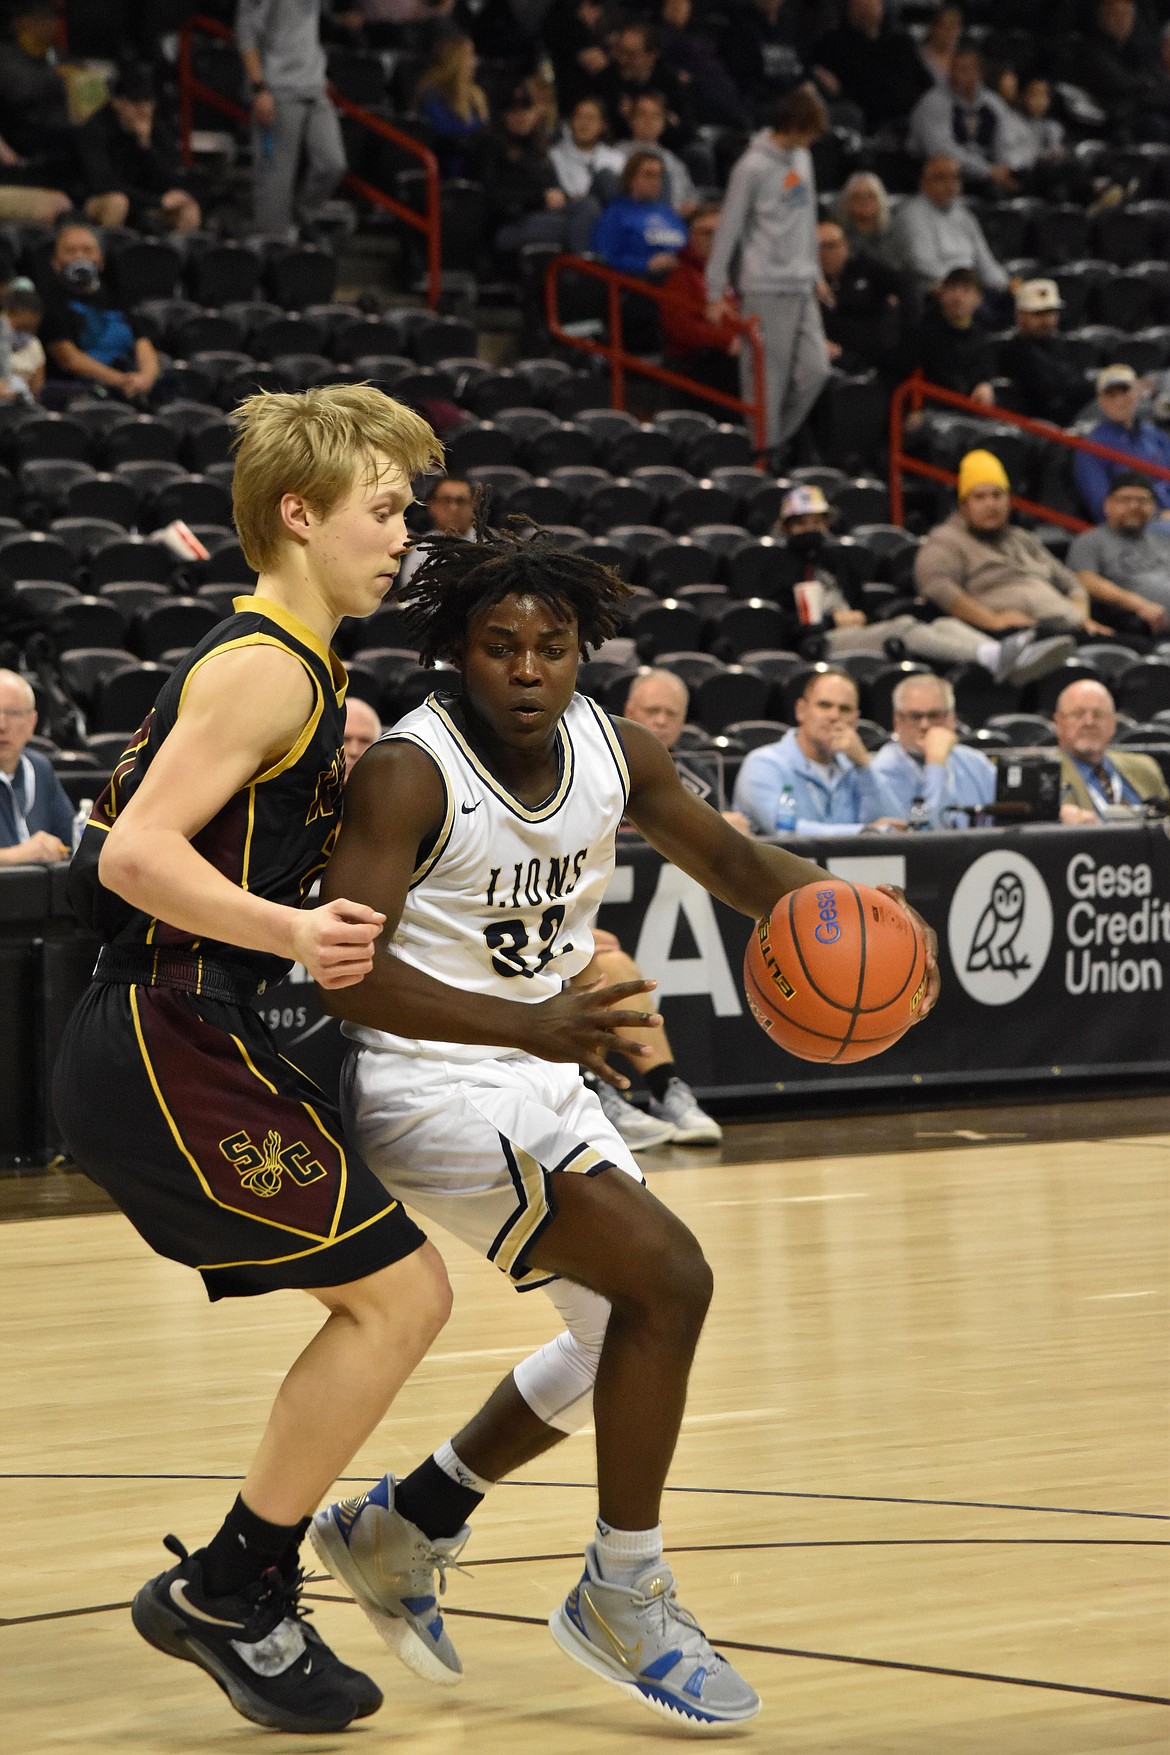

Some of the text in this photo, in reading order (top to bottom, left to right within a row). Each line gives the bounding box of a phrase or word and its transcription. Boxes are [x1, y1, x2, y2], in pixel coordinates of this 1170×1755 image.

[486, 847, 588, 909] LIONS
[1066, 852, 1152, 899] Gesa
[483, 905, 574, 978] 32
[815, 890, 841, 945] Gesa
[1066, 898, 1170, 947] Credit
[1065, 947, 1163, 995] Union
